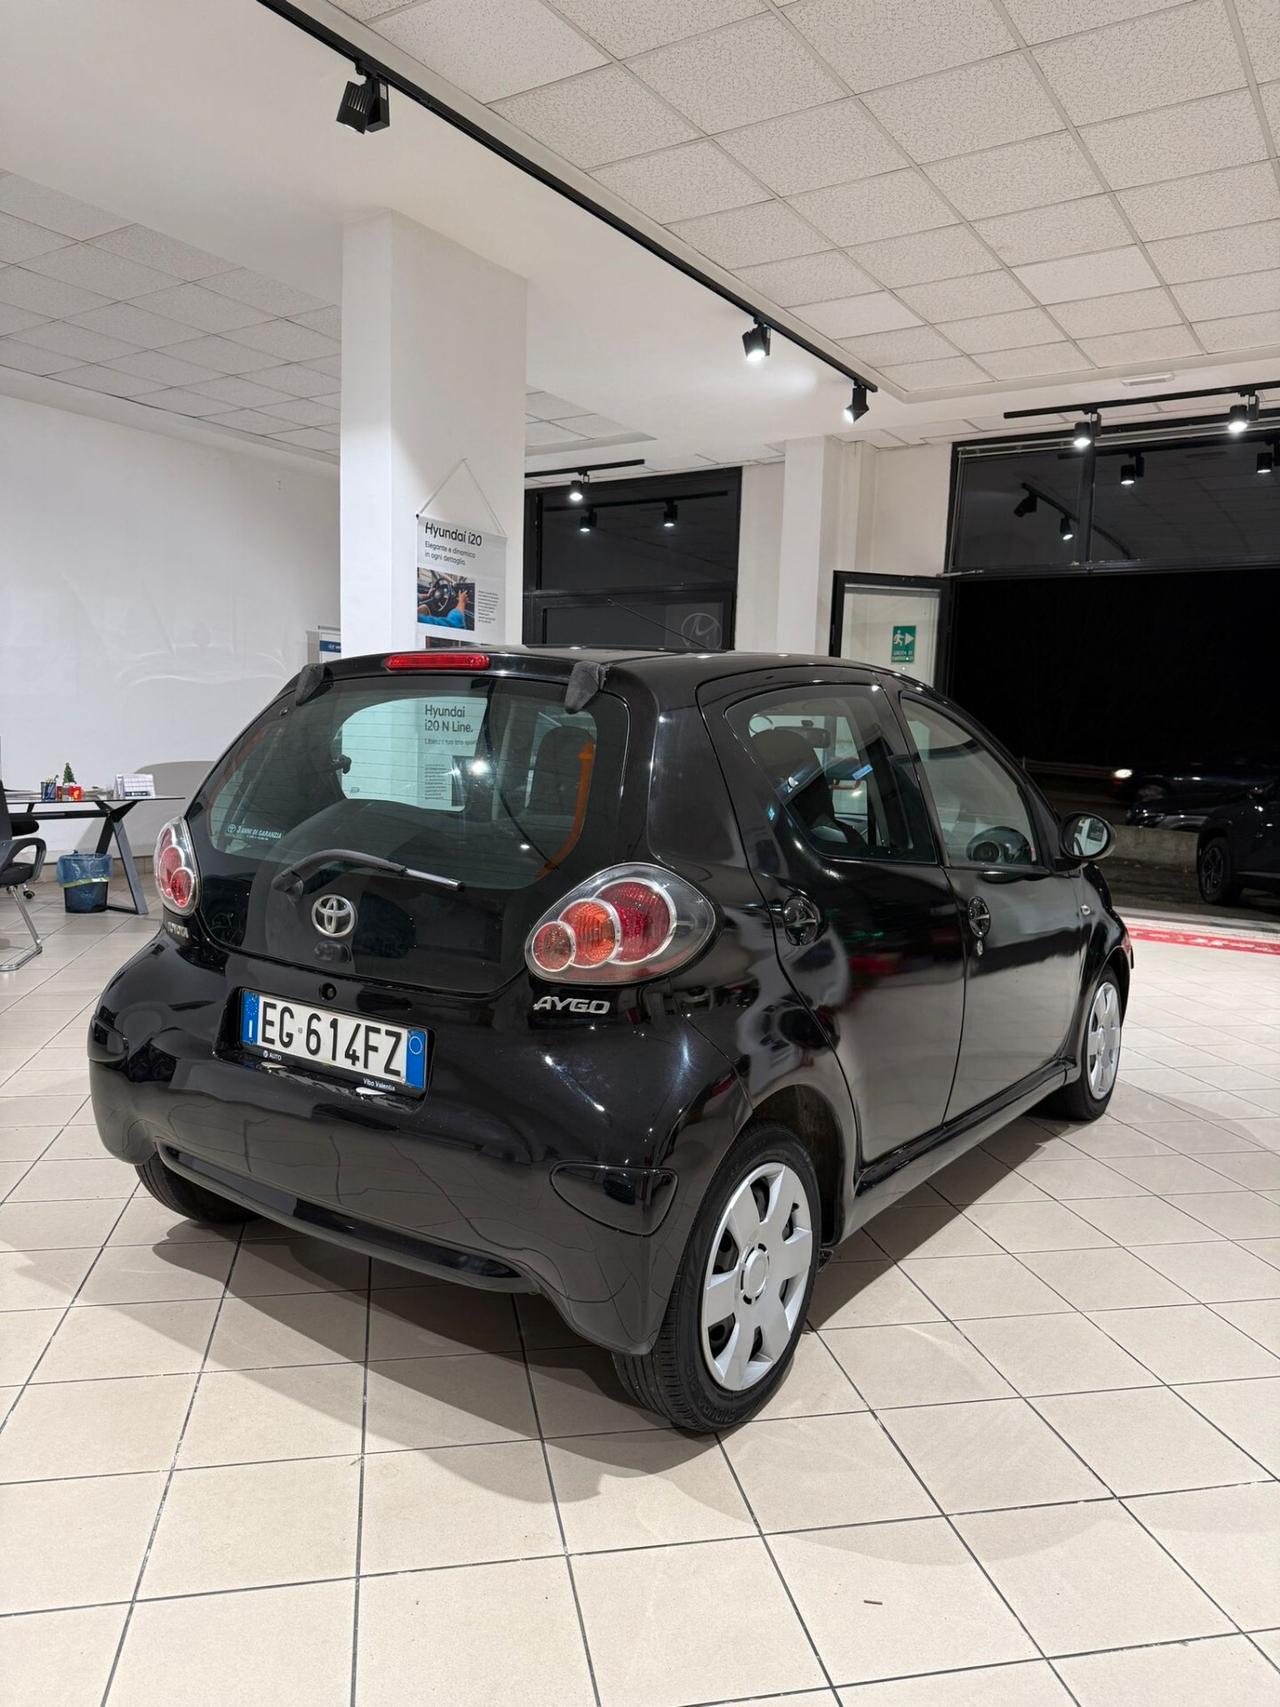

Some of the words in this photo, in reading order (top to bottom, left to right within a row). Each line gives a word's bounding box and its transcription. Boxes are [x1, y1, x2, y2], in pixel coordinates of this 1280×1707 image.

[425, 521, 467, 543] Hyundai
[468, 532, 483, 546] i20
[425, 704, 465, 719] Hyundai
[425, 719, 440, 731] i20
[442, 720, 450, 732] N
[452, 720, 474, 733] Line.
[533, 996, 611, 1014] AYGO
[261, 1000, 295, 1049] EG
[305, 1012, 403, 1077] 614FZ
[363, 1077, 375, 1087] Vibo
[375, 1081, 396, 1092] Valentia
